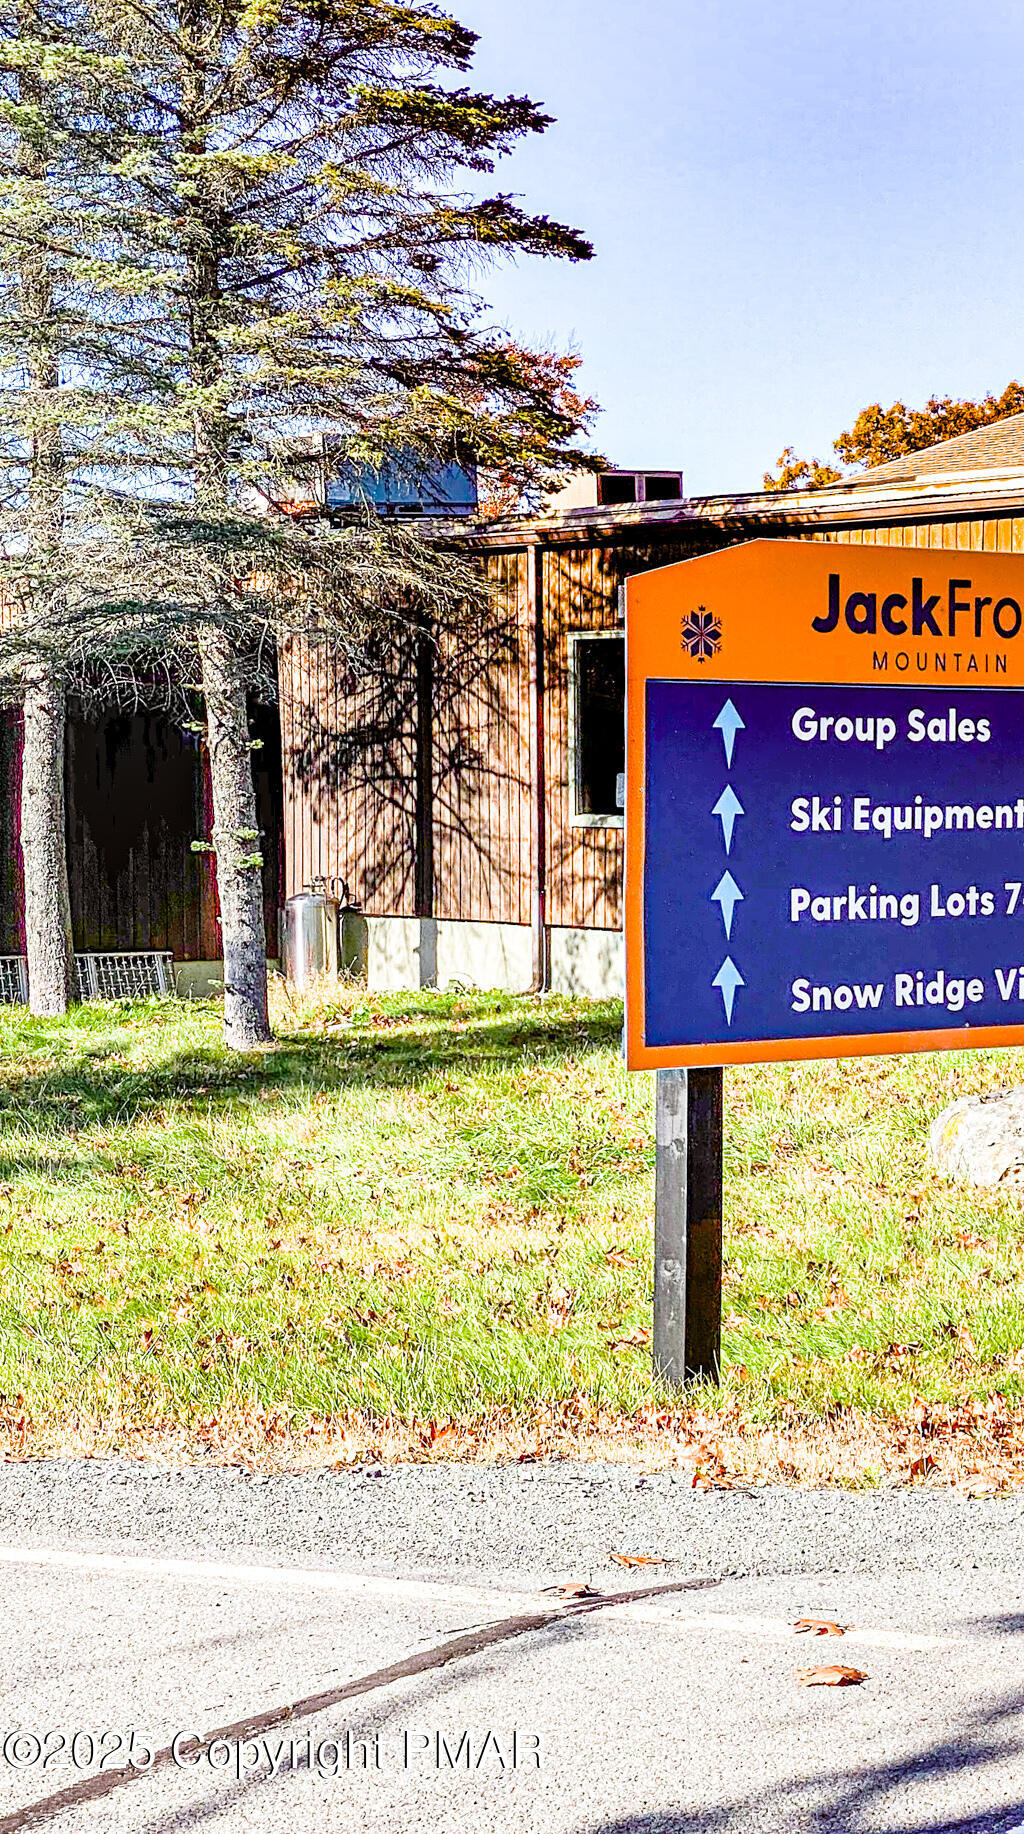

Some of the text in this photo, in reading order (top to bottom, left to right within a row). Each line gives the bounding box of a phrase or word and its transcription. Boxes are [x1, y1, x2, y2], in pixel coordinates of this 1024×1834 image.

[872, 651, 1008, 674] MOUNTAIN
[791, 706, 992, 751] Group Sales
[790, 796, 843, 833] Ski
[790, 885, 921, 926] Parking
[931, 884, 996, 918] Lots
[791, 979, 885, 1013] Snow
[895, 971, 985, 1012] Ridge
